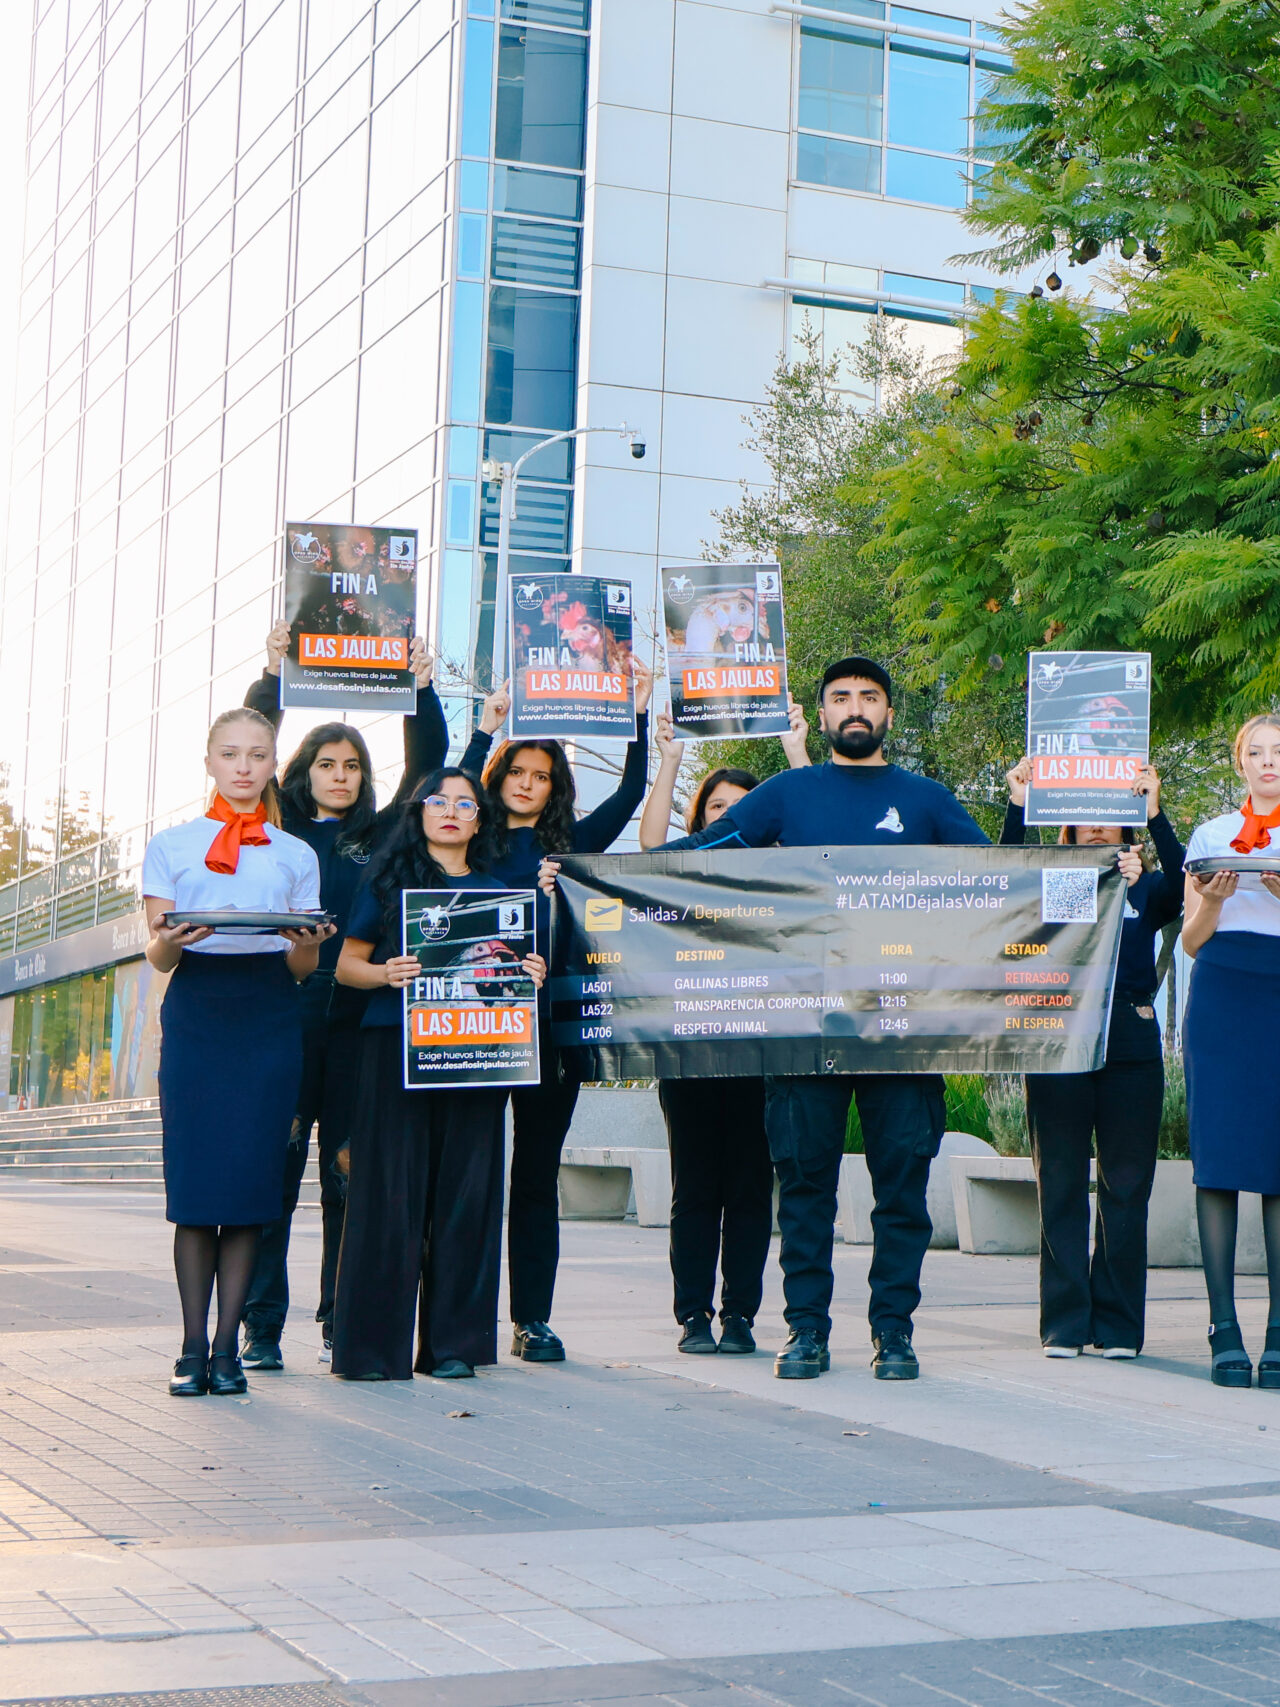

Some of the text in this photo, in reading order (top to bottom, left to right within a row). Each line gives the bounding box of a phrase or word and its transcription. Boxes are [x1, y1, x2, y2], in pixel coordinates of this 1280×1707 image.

[332, 572, 377, 595] FIN A
[305, 638, 402, 661] LAS JAULAS
[529, 647, 571, 666] FIN A
[735, 643, 775, 662] FIN A
[289, 681, 411, 693] www.desafiosinjaulas.com
[532, 674, 622, 694] LAS JAULAS
[688, 670, 775, 690] LAS JAULAS
[518, 713, 631, 723] www.desafiosinjaulas.com
[523, 705, 544, 713] Exige
[677, 712, 785, 722] www.desafiosinjaulas.com
[1037, 734, 1079, 754] FIN A
[1039, 760, 1136, 780] LAS JAULAS
[1037, 807, 1138, 815] www.desafiosinjaulas.com
[835, 870, 1008, 890] www.dejalasvolar.org
[835, 892, 1006, 912] #LATAMDéjalasVolar
[629, 904, 774, 922] Salidas / Departures
[586, 944, 1048, 964] VUELO DESTINO HORA ESTADO
[414, 977, 464, 1000] FIN A
[582, 972, 1069, 994] LA501 GALLINAS LIBRES 11:00 RETRASADO
[582, 995, 1072, 1016] LA522 TRANSPARENCIA CORPORATIVA 12:15 CANCELADO
[418, 1011, 524, 1035] LAS JAULAS
[582, 1018, 1064, 1039] LA706 RESPETO ANIMAL 12:45 EN ESPERA
[418, 1060, 529, 1070] www.desafiosinjaulas.com
[419, 1052, 442, 1060] Exige
[499, 1050, 510, 1058] de
